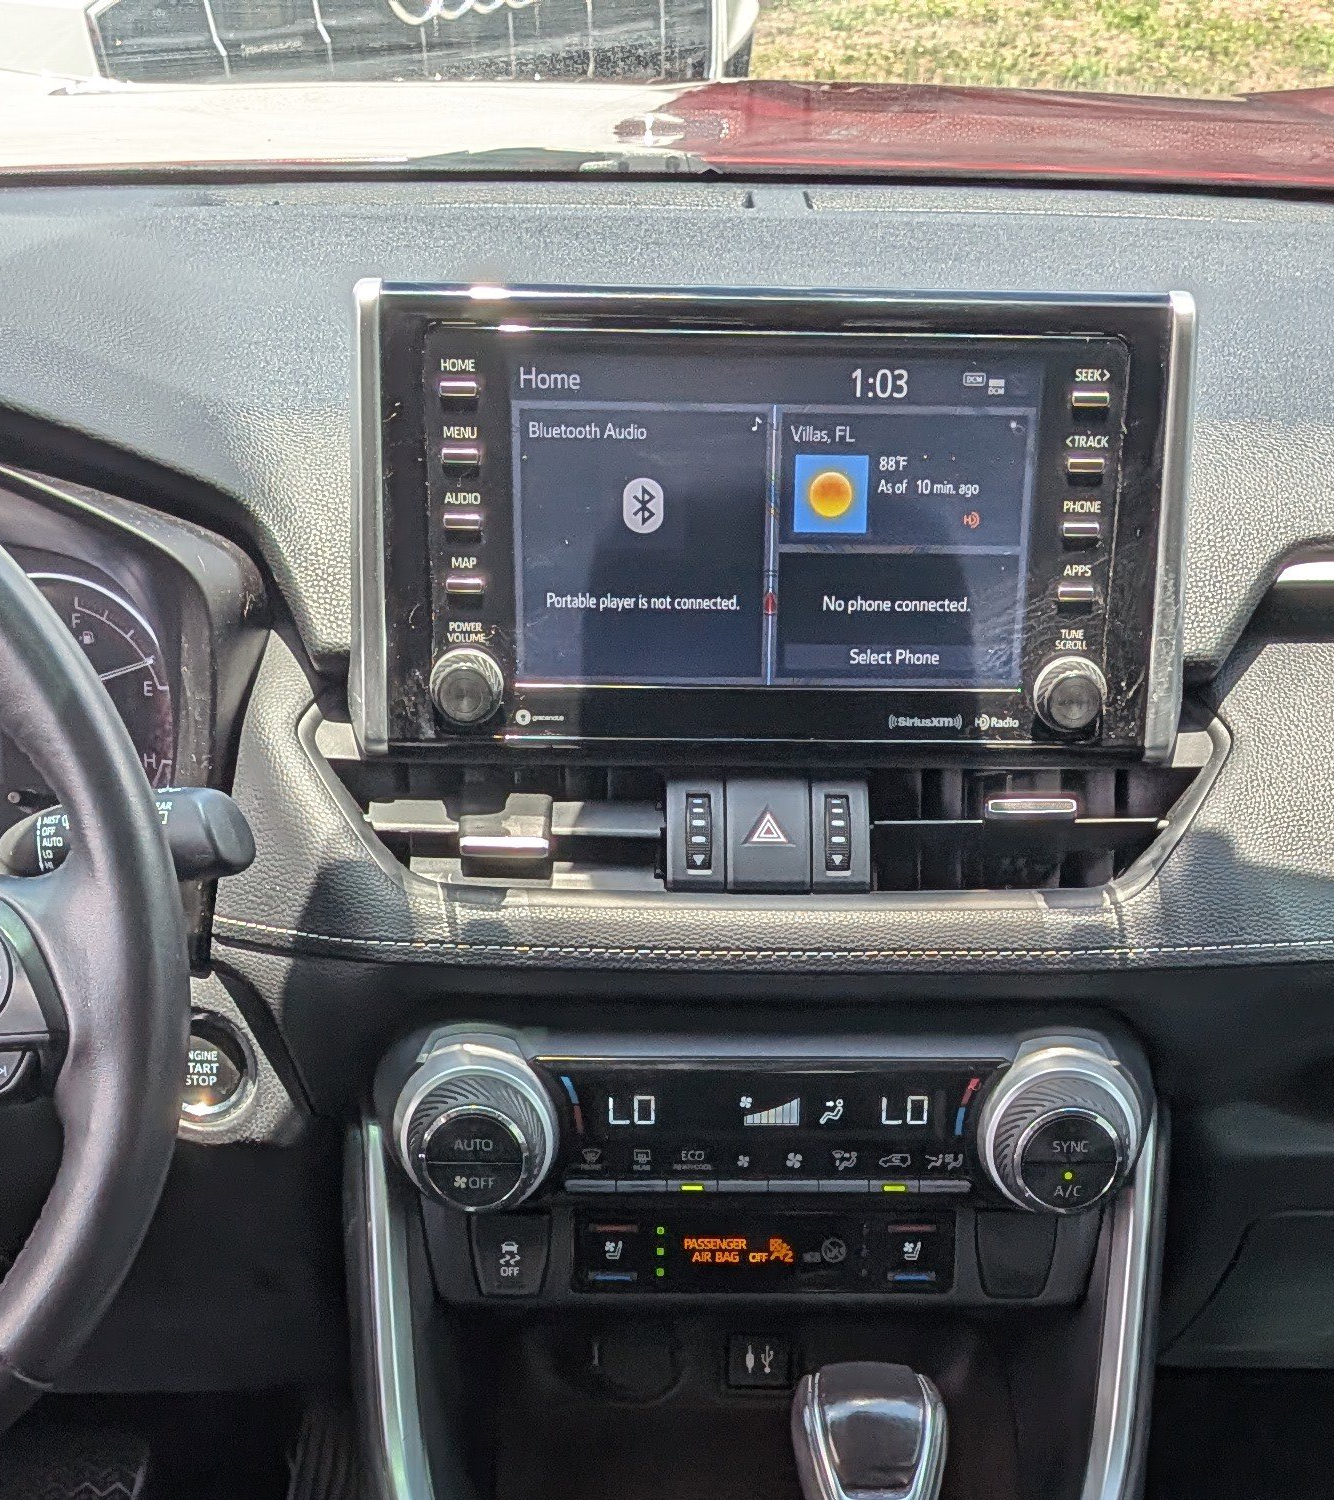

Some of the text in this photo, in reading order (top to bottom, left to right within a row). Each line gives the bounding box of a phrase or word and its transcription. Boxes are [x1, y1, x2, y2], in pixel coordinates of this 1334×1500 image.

[440, 358, 476, 372] HOME
[519, 366, 581, 390] Home
[851, 368, 909, 399] 1:03
[443, 425, 478, 439] MENU
[528, 421, 648, 440] Bluetooth Audio
[790, 425, 856, 444] Villas, FL
[877, 478, 980, 498] As of 10 min. ago
[444, 492, 482, 505] AUDIO
[1063, 500, 1102, 513] PHONE
[451, 556, 478, 569] MAP
[1063, 564, 1093, 577] APPS
[546, 591, 741, 612] Portable player is not connected.
[822, 595, 972, 615] No phone connected.
[71, 613, 81, 629] F
[449, 621, 482, 632] POWER
[447, 632, 486, 643] VOLUME
[1060, 629, 1085, 640] TUNE
[1055, 640, 1088, 650] SCROLL
[849, 648, 941, 665] Select Phone
[143, 680, 154, 697] E
[990, 716, 1020, 729] Radio
[143, 753, 157, 769] H
[42, 826, 56, 836] OFF
[42, 836, 64, 847] AUTO
[42, 849, 53, 859] LO
[188, 1050, 218, 1061] NGINE
[187, 1062, 219, 1074] TART
[185, 1074, 218, 1086] STOP
[608, 1095, 656, 1125] LO
[880, 1095, 929, 1125] LO
[453, 1138, 494, 1152] AUTO
[1052, 1139, 1091, 1153] SYNC
[681, 1150, 705, 1162] ECO
[468, 1176, 496, 1190] OFF
[1053, 1184, 1082, 1198] A/C
[683, 1238, 747, 1250] PASSENGER
[691, 1252, 712, 1263] AIR
[714, 1252, 740, 1263] BAG
[748, 1252, 768, 1263] OFF
[499, 1266, 520, 1277] OFF
